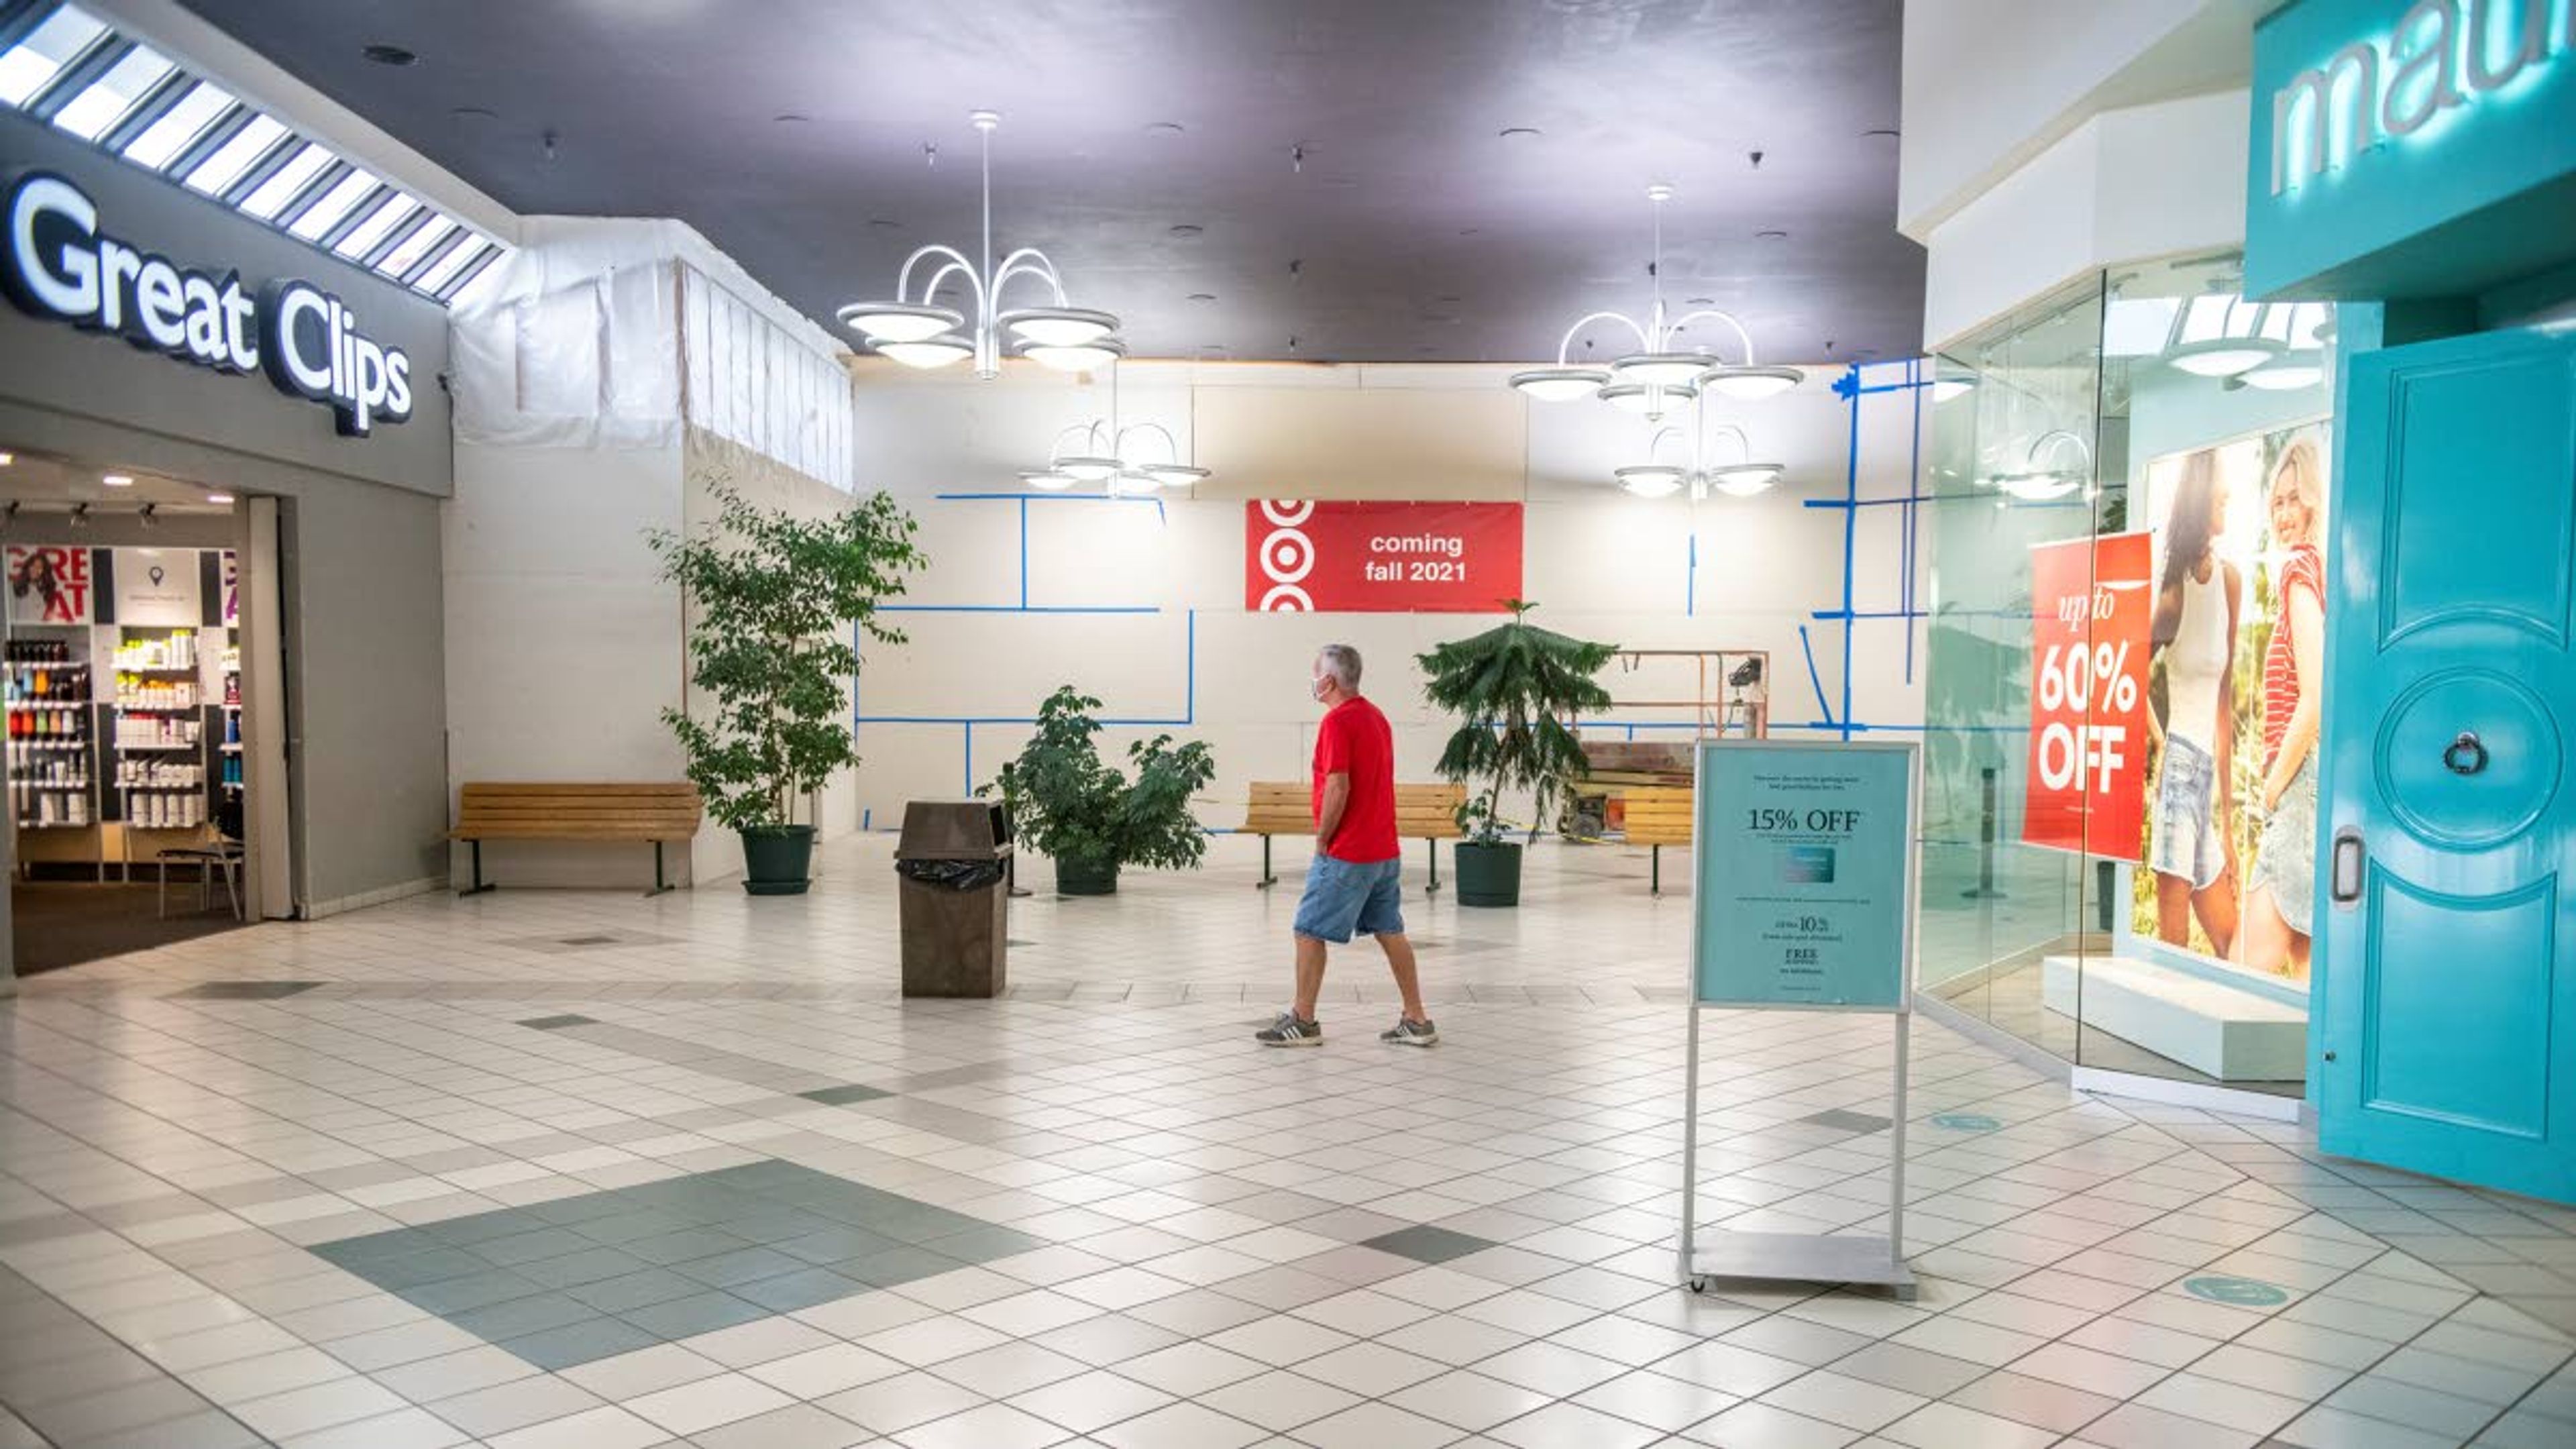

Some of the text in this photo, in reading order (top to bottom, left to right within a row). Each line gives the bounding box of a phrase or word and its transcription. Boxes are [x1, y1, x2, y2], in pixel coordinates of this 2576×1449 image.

[2271, 0, 2576, 197] mau
[12, 178, 411, 430] Great Clips
[1371, 533, 1463, 556] coming
[1365, 562, 1465, 581] fall 2021
[2059, 586, 2114, 632] up to
[2039, 639, 2137, 714] 60%
[2039, 722, 2126, 794] OFF
[1748, 808, 1860, 831] 15% OFF
[1786, 948, 1819, 959] FREE
